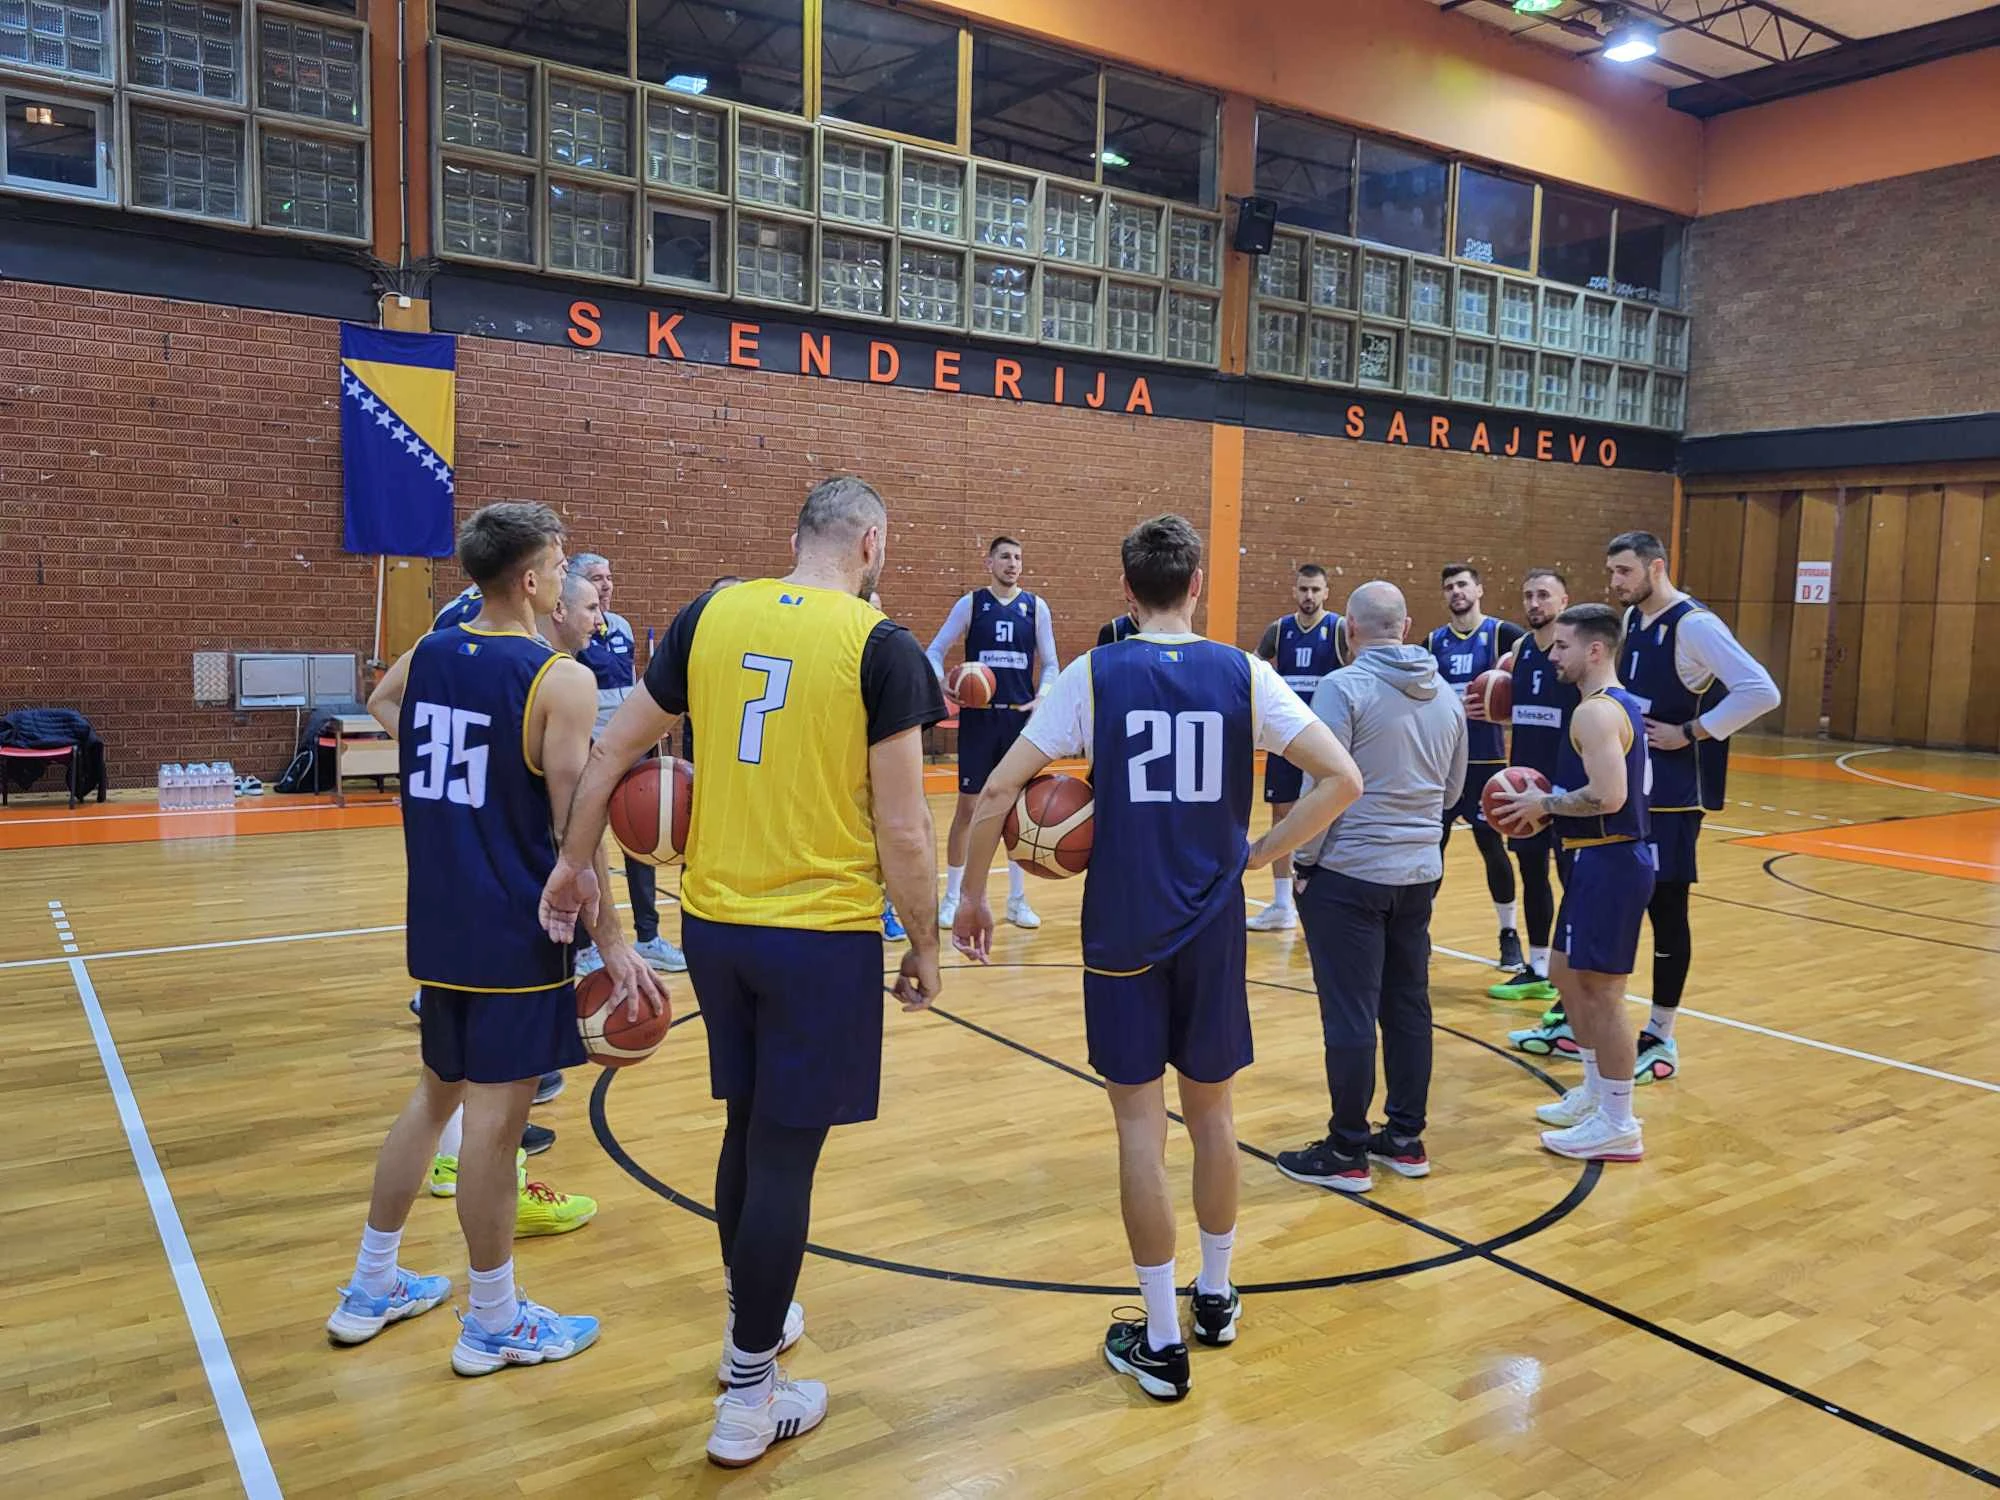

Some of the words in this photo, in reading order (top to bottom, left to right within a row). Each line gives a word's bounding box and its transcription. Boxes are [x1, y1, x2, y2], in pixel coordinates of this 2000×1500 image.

[568, 300, 1153, 415] SKENDERIJA
[1345, 405, 1618, 467] SARAJEVO
[995, 620, 1014, 643] 51
[1295, 647, 1313, 668] 10
[1450, 653, 1474, 675] 30
[1629, 650, 1639, 680] 1
[737, 652, 793, 765] 7
[409, 701, 492, 809] 35
[1126, 709, 1223, 803] 20
